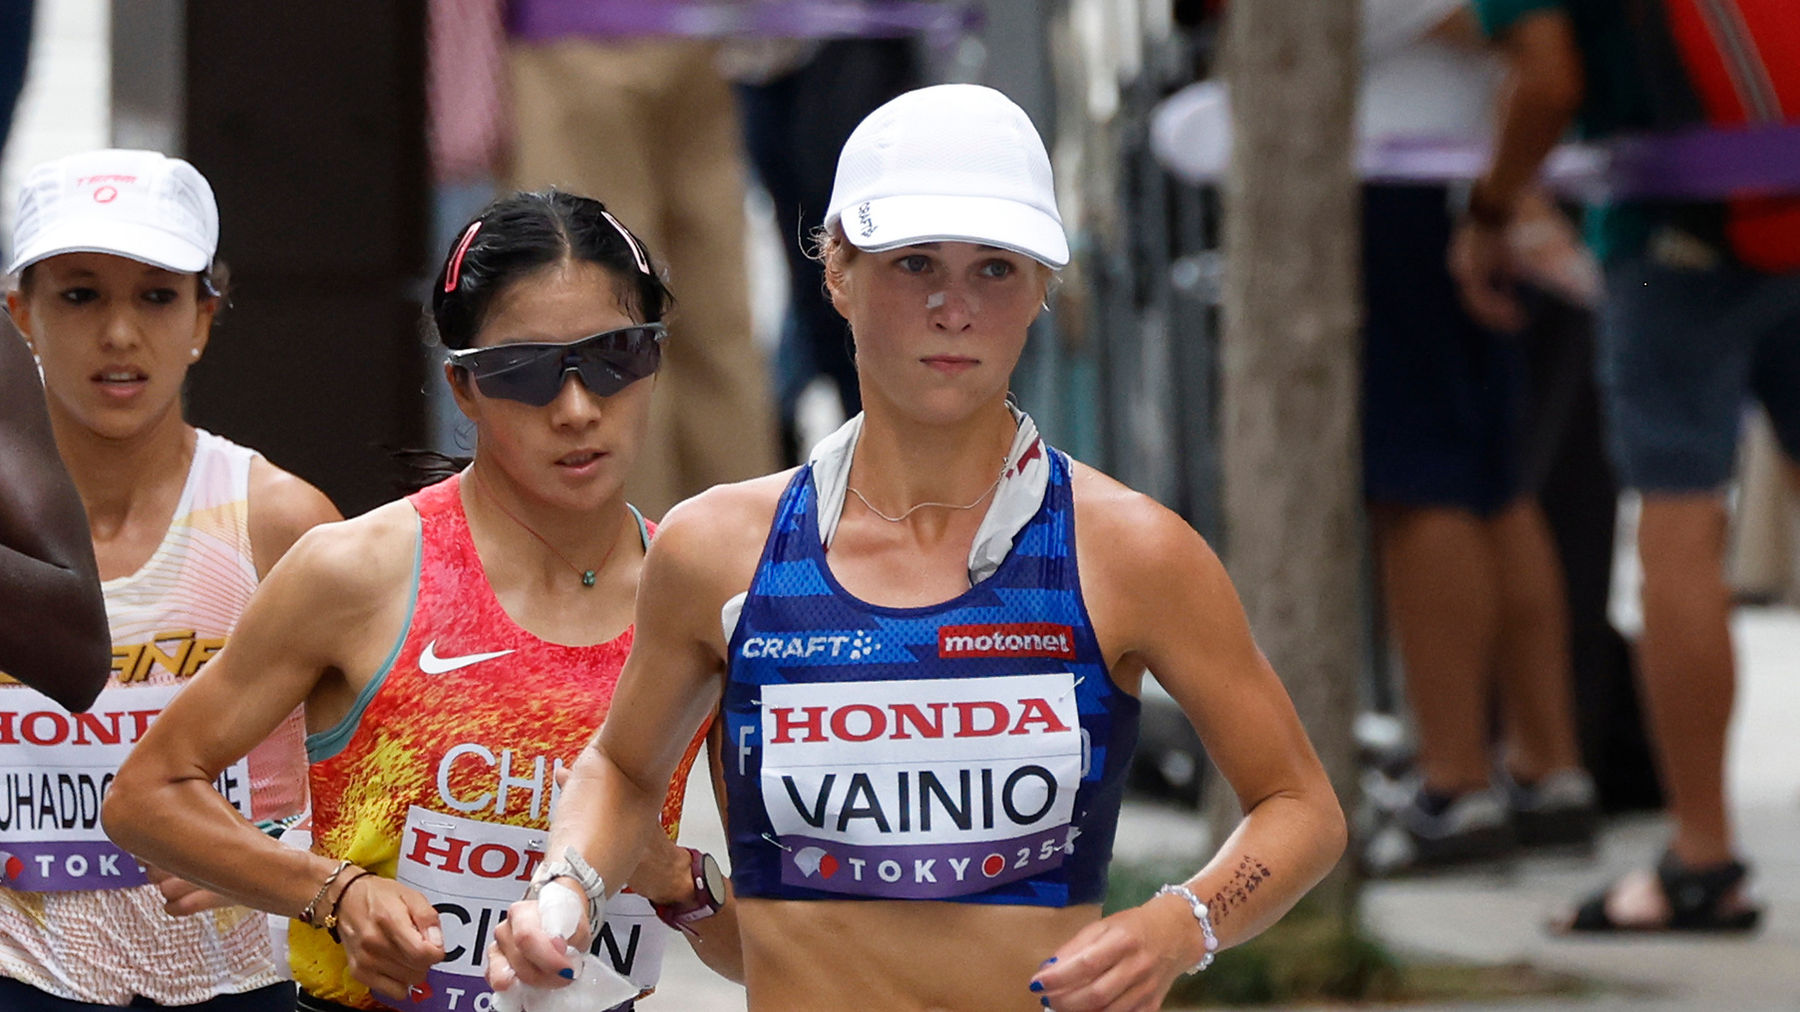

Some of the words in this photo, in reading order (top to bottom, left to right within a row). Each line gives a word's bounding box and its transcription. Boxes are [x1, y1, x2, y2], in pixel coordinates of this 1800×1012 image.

[742, 636, 850, 659] CRAFT
[945, 630, 1070, 652] motonet
[770, 698, 1072, 744] HONDA
[782, 765, 1058, 833] VAINIO
[35, 854, 147, 877] TOK
